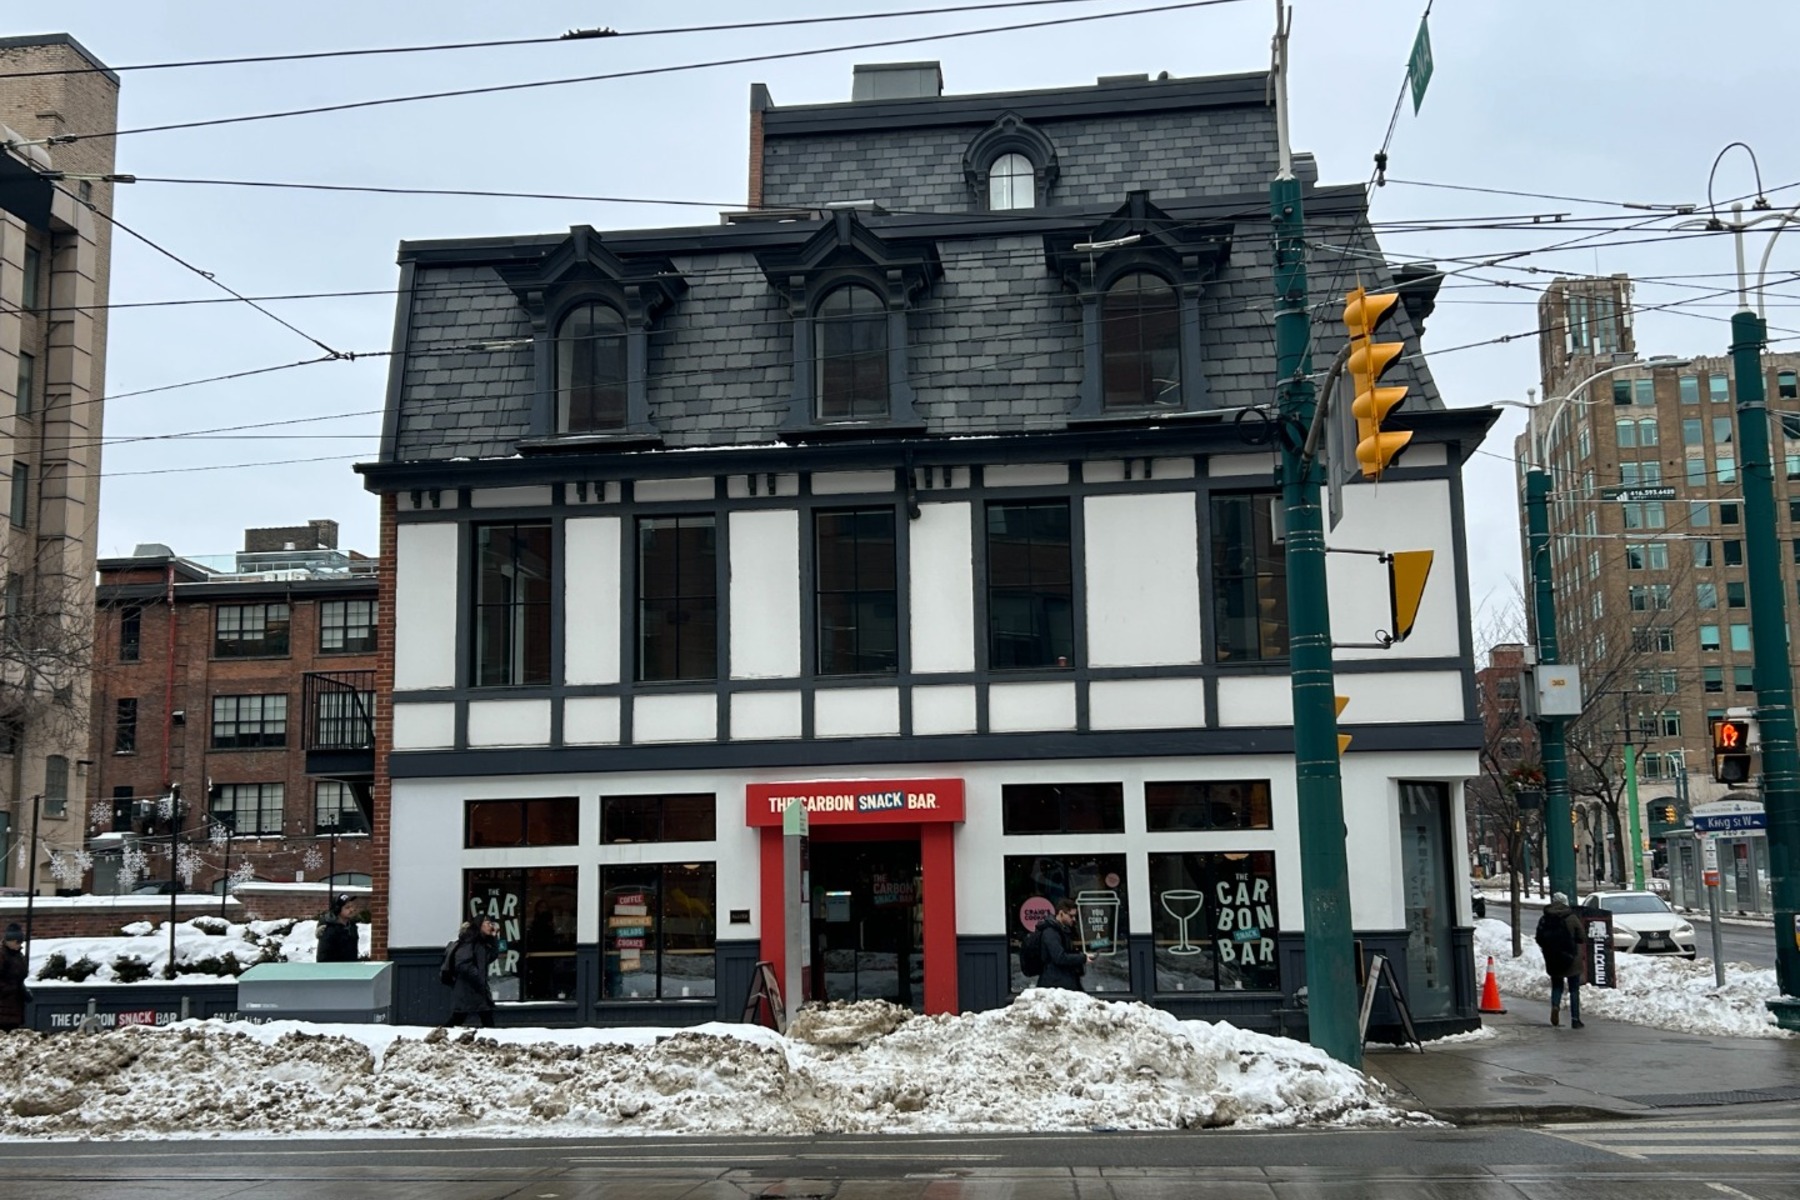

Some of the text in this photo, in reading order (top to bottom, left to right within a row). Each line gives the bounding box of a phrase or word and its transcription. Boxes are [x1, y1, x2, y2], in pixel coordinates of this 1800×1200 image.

[859, 792, 903, 810] SNACK
[488, 888, 500, 896] THE
[1216, 878, 1269, 905] CAR
[470, 893, 518, 919] CAR
[1217, 904, 1274, 931] BON
[1088, 916, 1108, 924] COULD
[488, 950, 519, 976] AR
[1217, 937, 1275, 965] BAR
[1593, 943, 1606, 985] FREE
[51, 1013, 71, 1027] THE
[118, 1011, 152, 1026] SNACK
